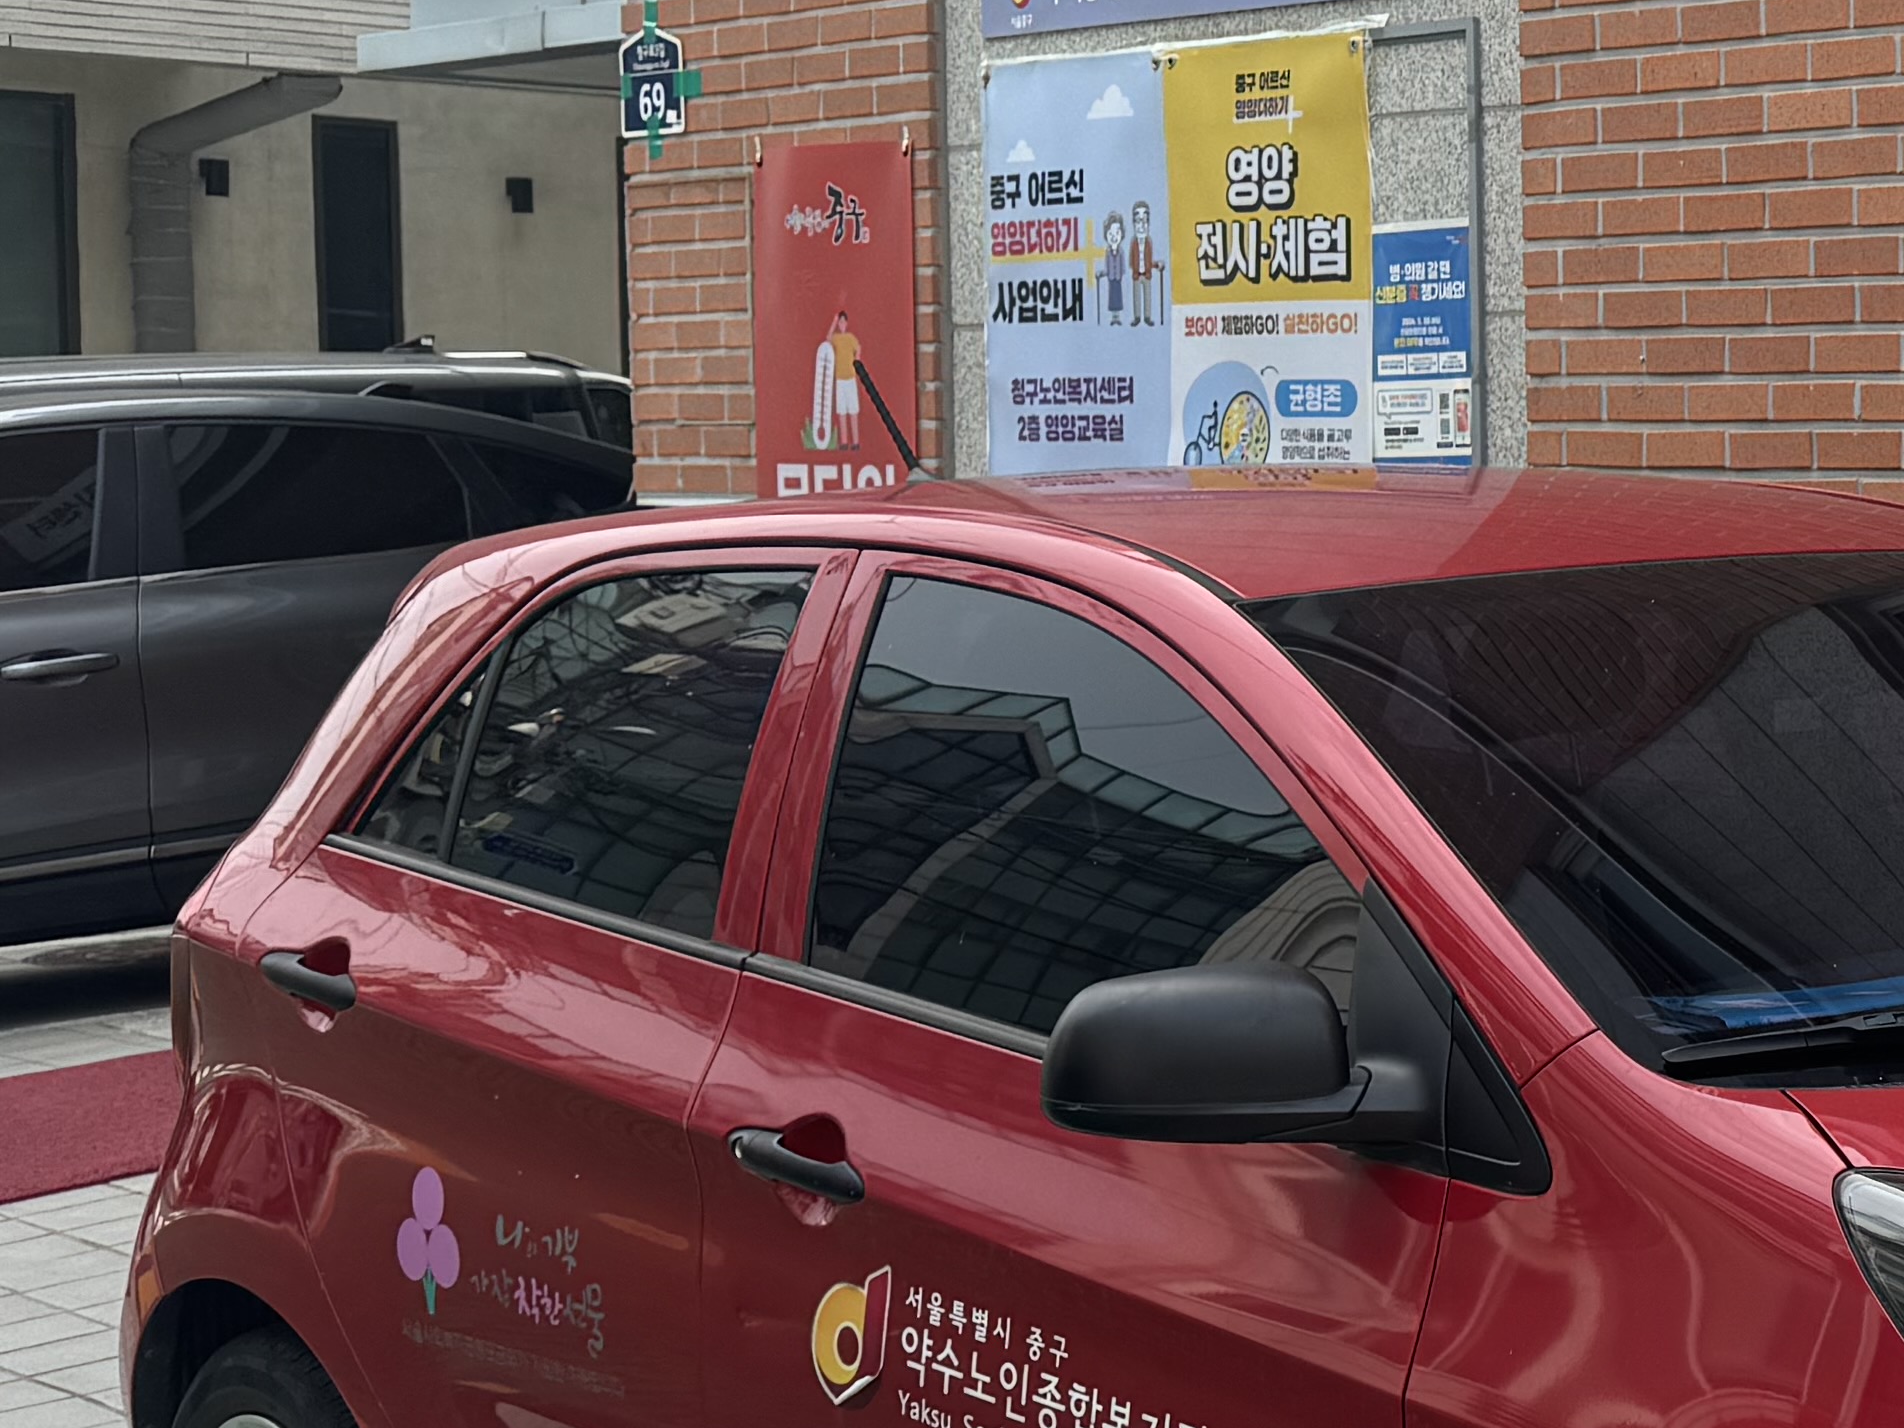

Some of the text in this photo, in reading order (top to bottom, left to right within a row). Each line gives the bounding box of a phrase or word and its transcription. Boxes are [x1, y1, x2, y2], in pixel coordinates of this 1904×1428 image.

[1235, 70, 1290, 93] 중구 어르신
[639, 82, 665, 122] 69
[990, 169, 1084, 210] 중구 어르신
[1226, 141, 1298, 212] 영양
[991, 217, 1079, 257] 영양더하기
[1195, 214, 1351, 286] 전시·체험
[992, 278, 1084, 324] 사업안내
[1011, 376, 1134, 405] 청구노인복지센터
[1289, 383, 1342, 412] 균형존
[1017, 414, 1124, 443] 2층 영양교육실
[514, 1275, 563, 1325] 착한
[905, 1286, 1069, 1368] 서울특별시 중구
